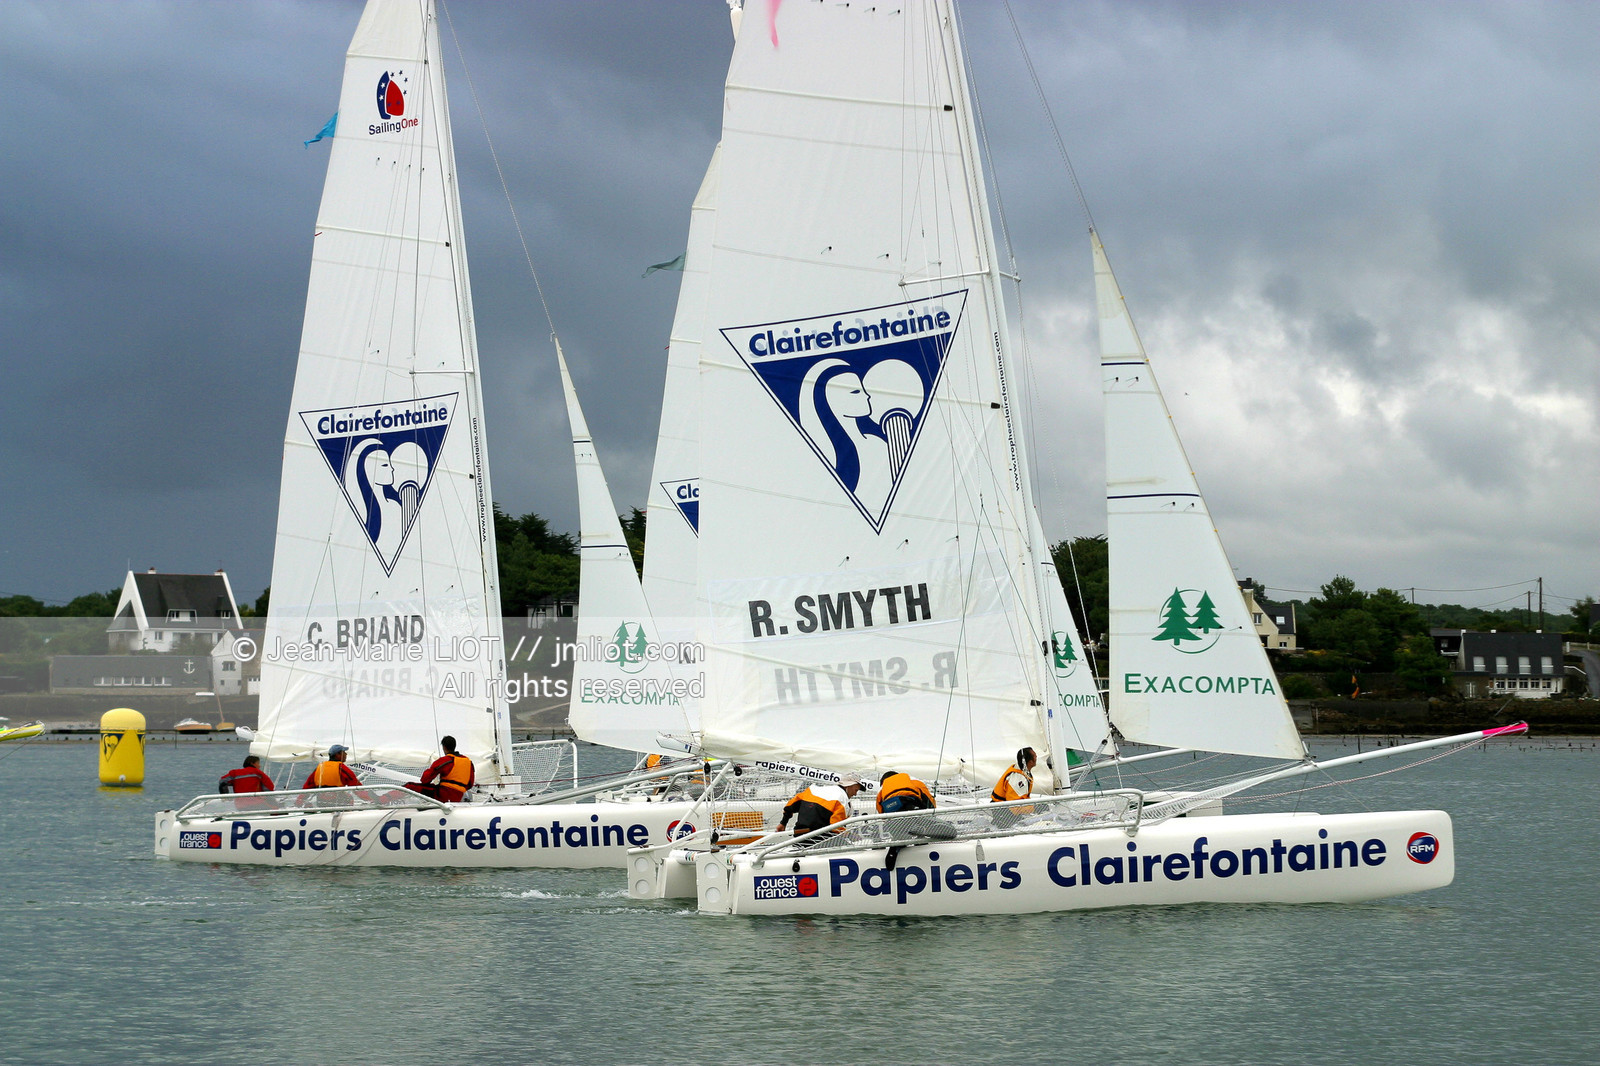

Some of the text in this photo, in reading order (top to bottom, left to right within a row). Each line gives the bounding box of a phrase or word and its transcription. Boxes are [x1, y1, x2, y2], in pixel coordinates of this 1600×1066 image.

[368, 118, 419, 135] SailingOne
[750, 309, 951, 357] Clairefontaine
[317, 404, 448, 435] Clairefontaine
[748, 582, 931, 637] R. SMYTH
[336, 615, 425, 648] BRIAND
[1124, 673, 1276, 695] EXACOMPTA
[180, 839, 208, 848] france
[183, 832, 209, 841] ouest
[230, 814, 650, 857] Papiers Clairefontaine
[1410, 844, 1435, 854] RFM
[829, 828, 1387, 904] Papiers Clairefontaine
[755, 885, 798, 899] france
[760, 875, 798, 889] ouest
